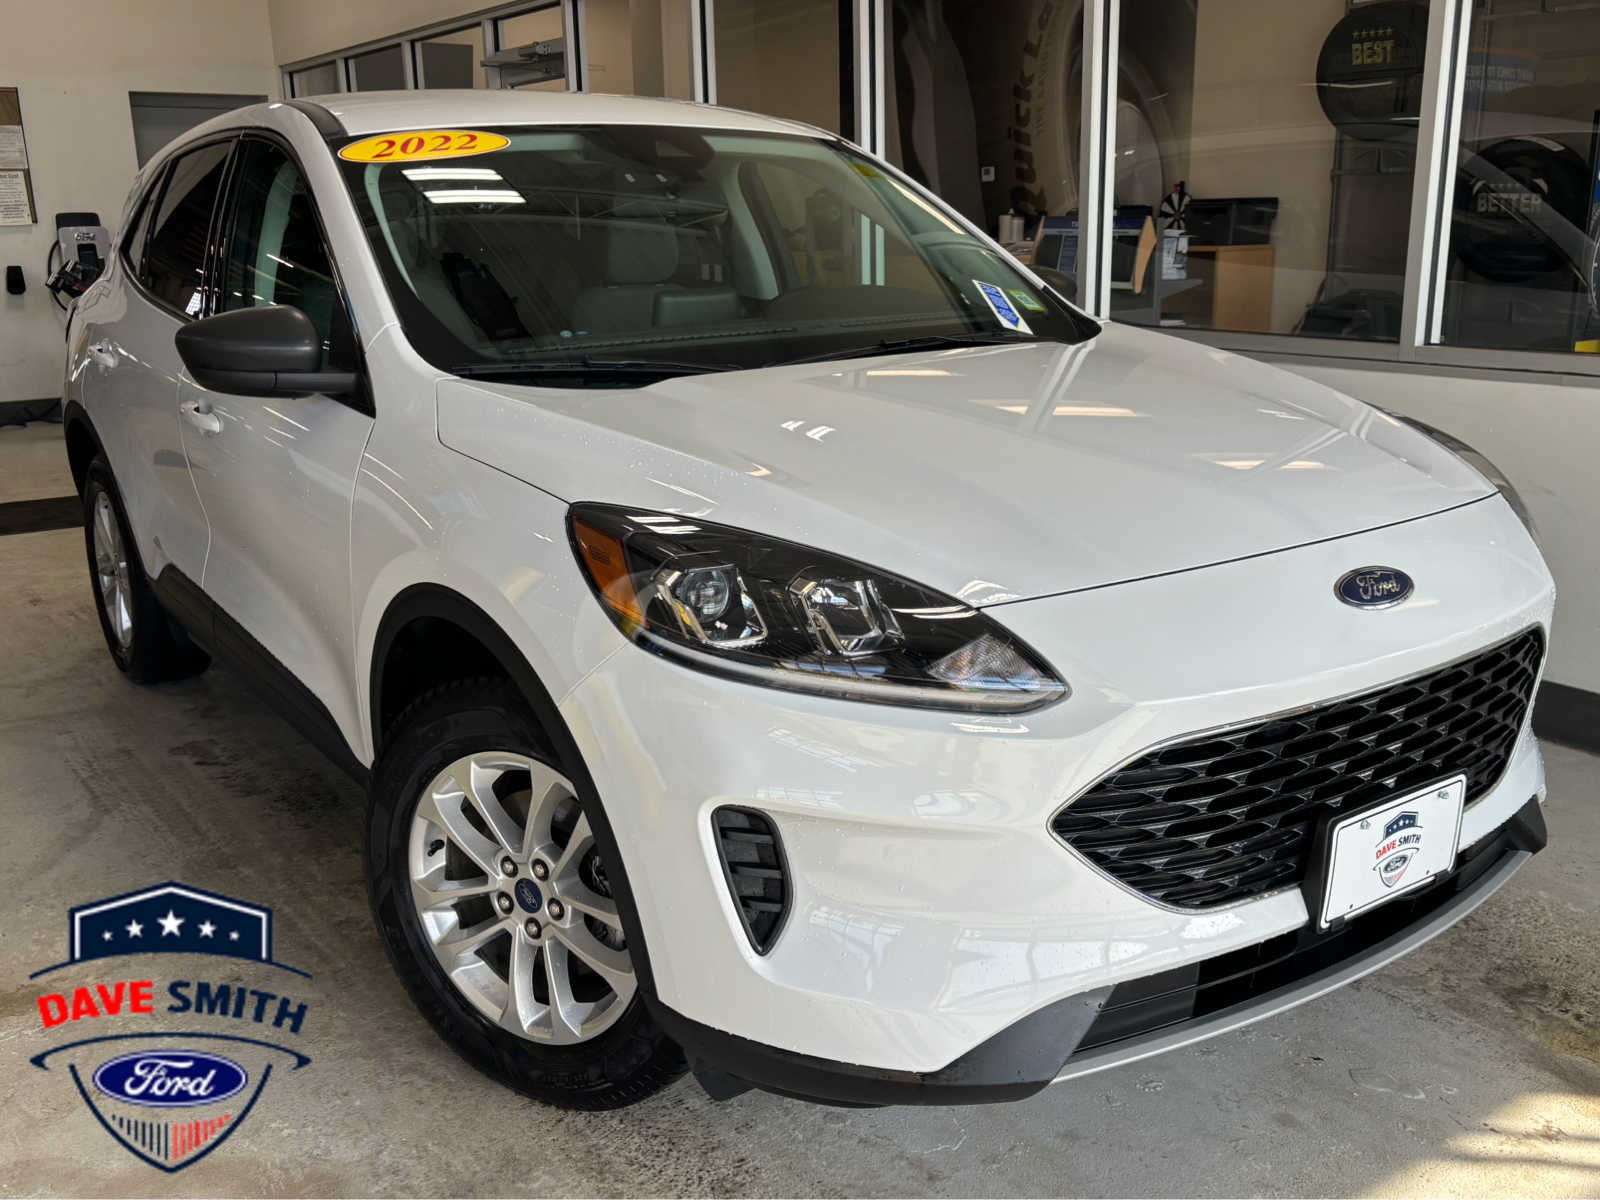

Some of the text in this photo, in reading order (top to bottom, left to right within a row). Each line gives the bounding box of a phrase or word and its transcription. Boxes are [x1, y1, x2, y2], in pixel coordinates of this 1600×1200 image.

[1352, 40, 1395, 65] BEST
[372, 134, 478, 159] 2022
[1477, 192, 1542, 213] BETTER
[1356, 570, 1401, 600] Ford
[1376, 834, 1421, 859] DAVE SMITH
